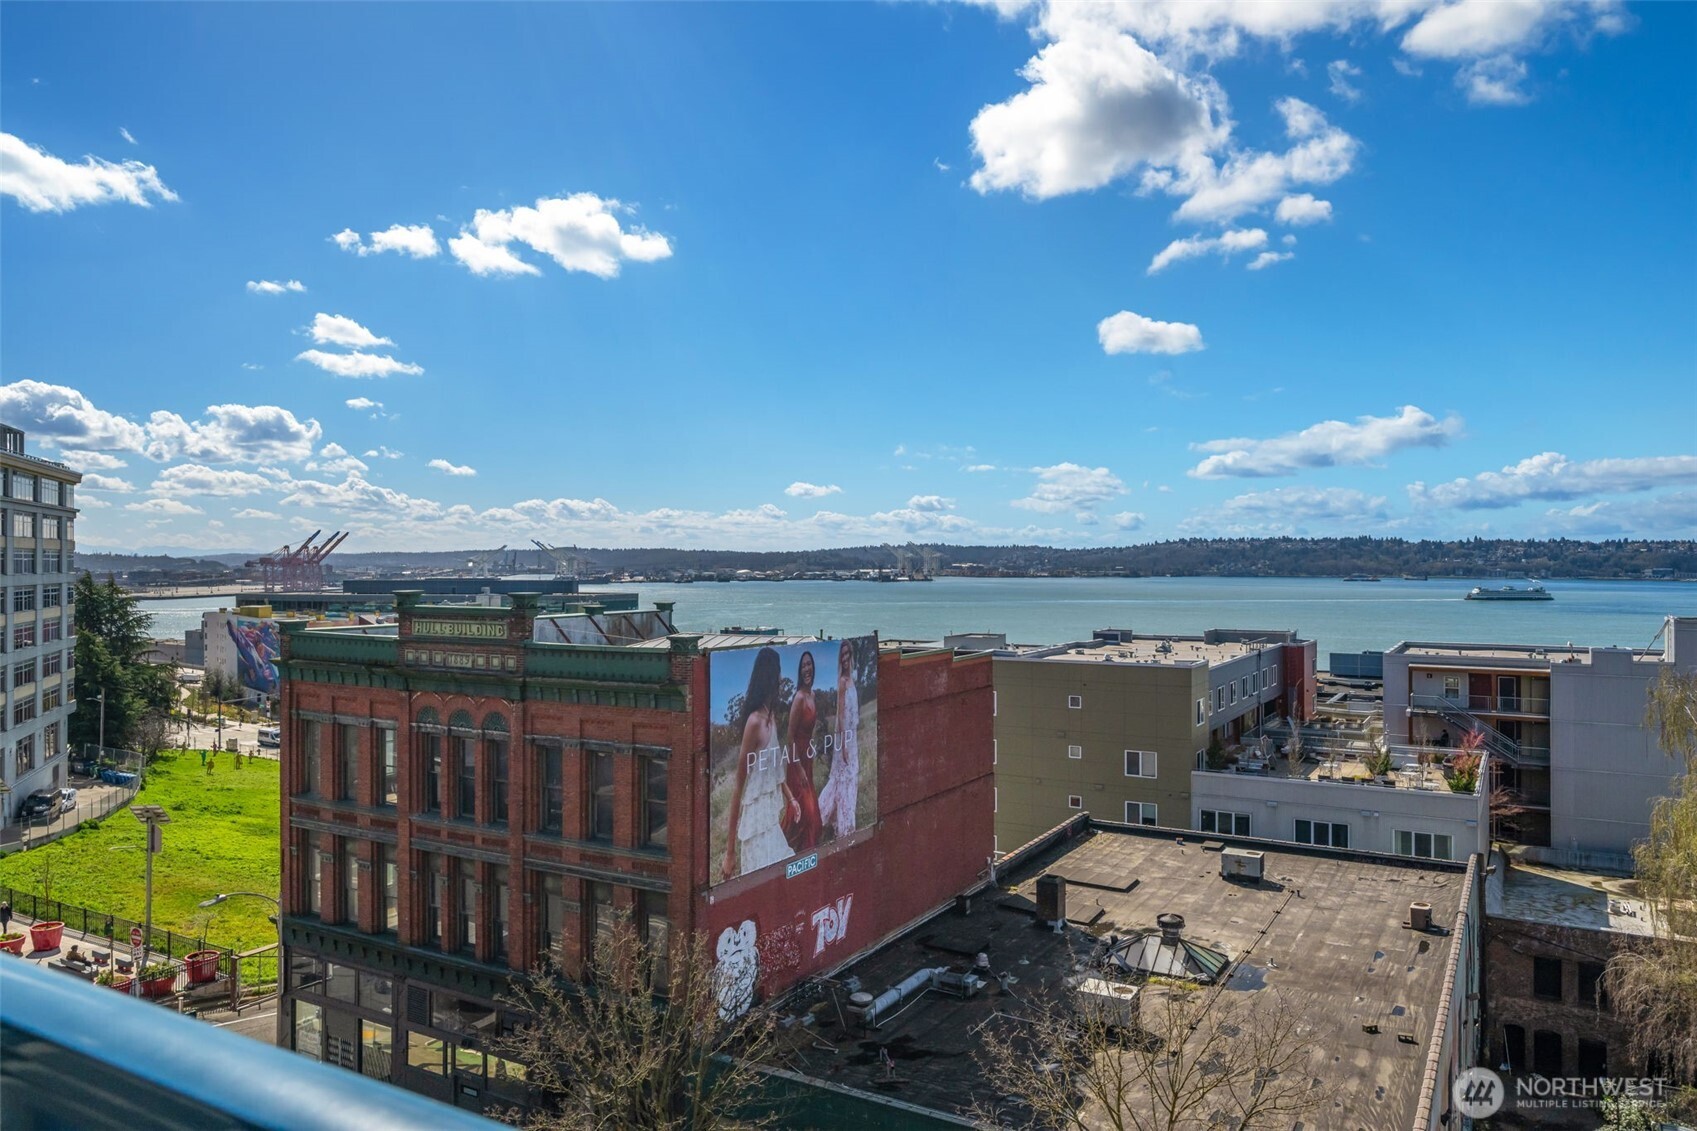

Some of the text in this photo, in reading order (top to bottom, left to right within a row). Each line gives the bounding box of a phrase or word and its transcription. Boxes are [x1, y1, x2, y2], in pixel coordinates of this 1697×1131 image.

[414, 621, 505, 637] HULL BUILDING
[447, 653, 470, 666] 1889
[746, 729, 853, 774] PETAL & PUP
[787, 856, 816, 877] PACIFIC
